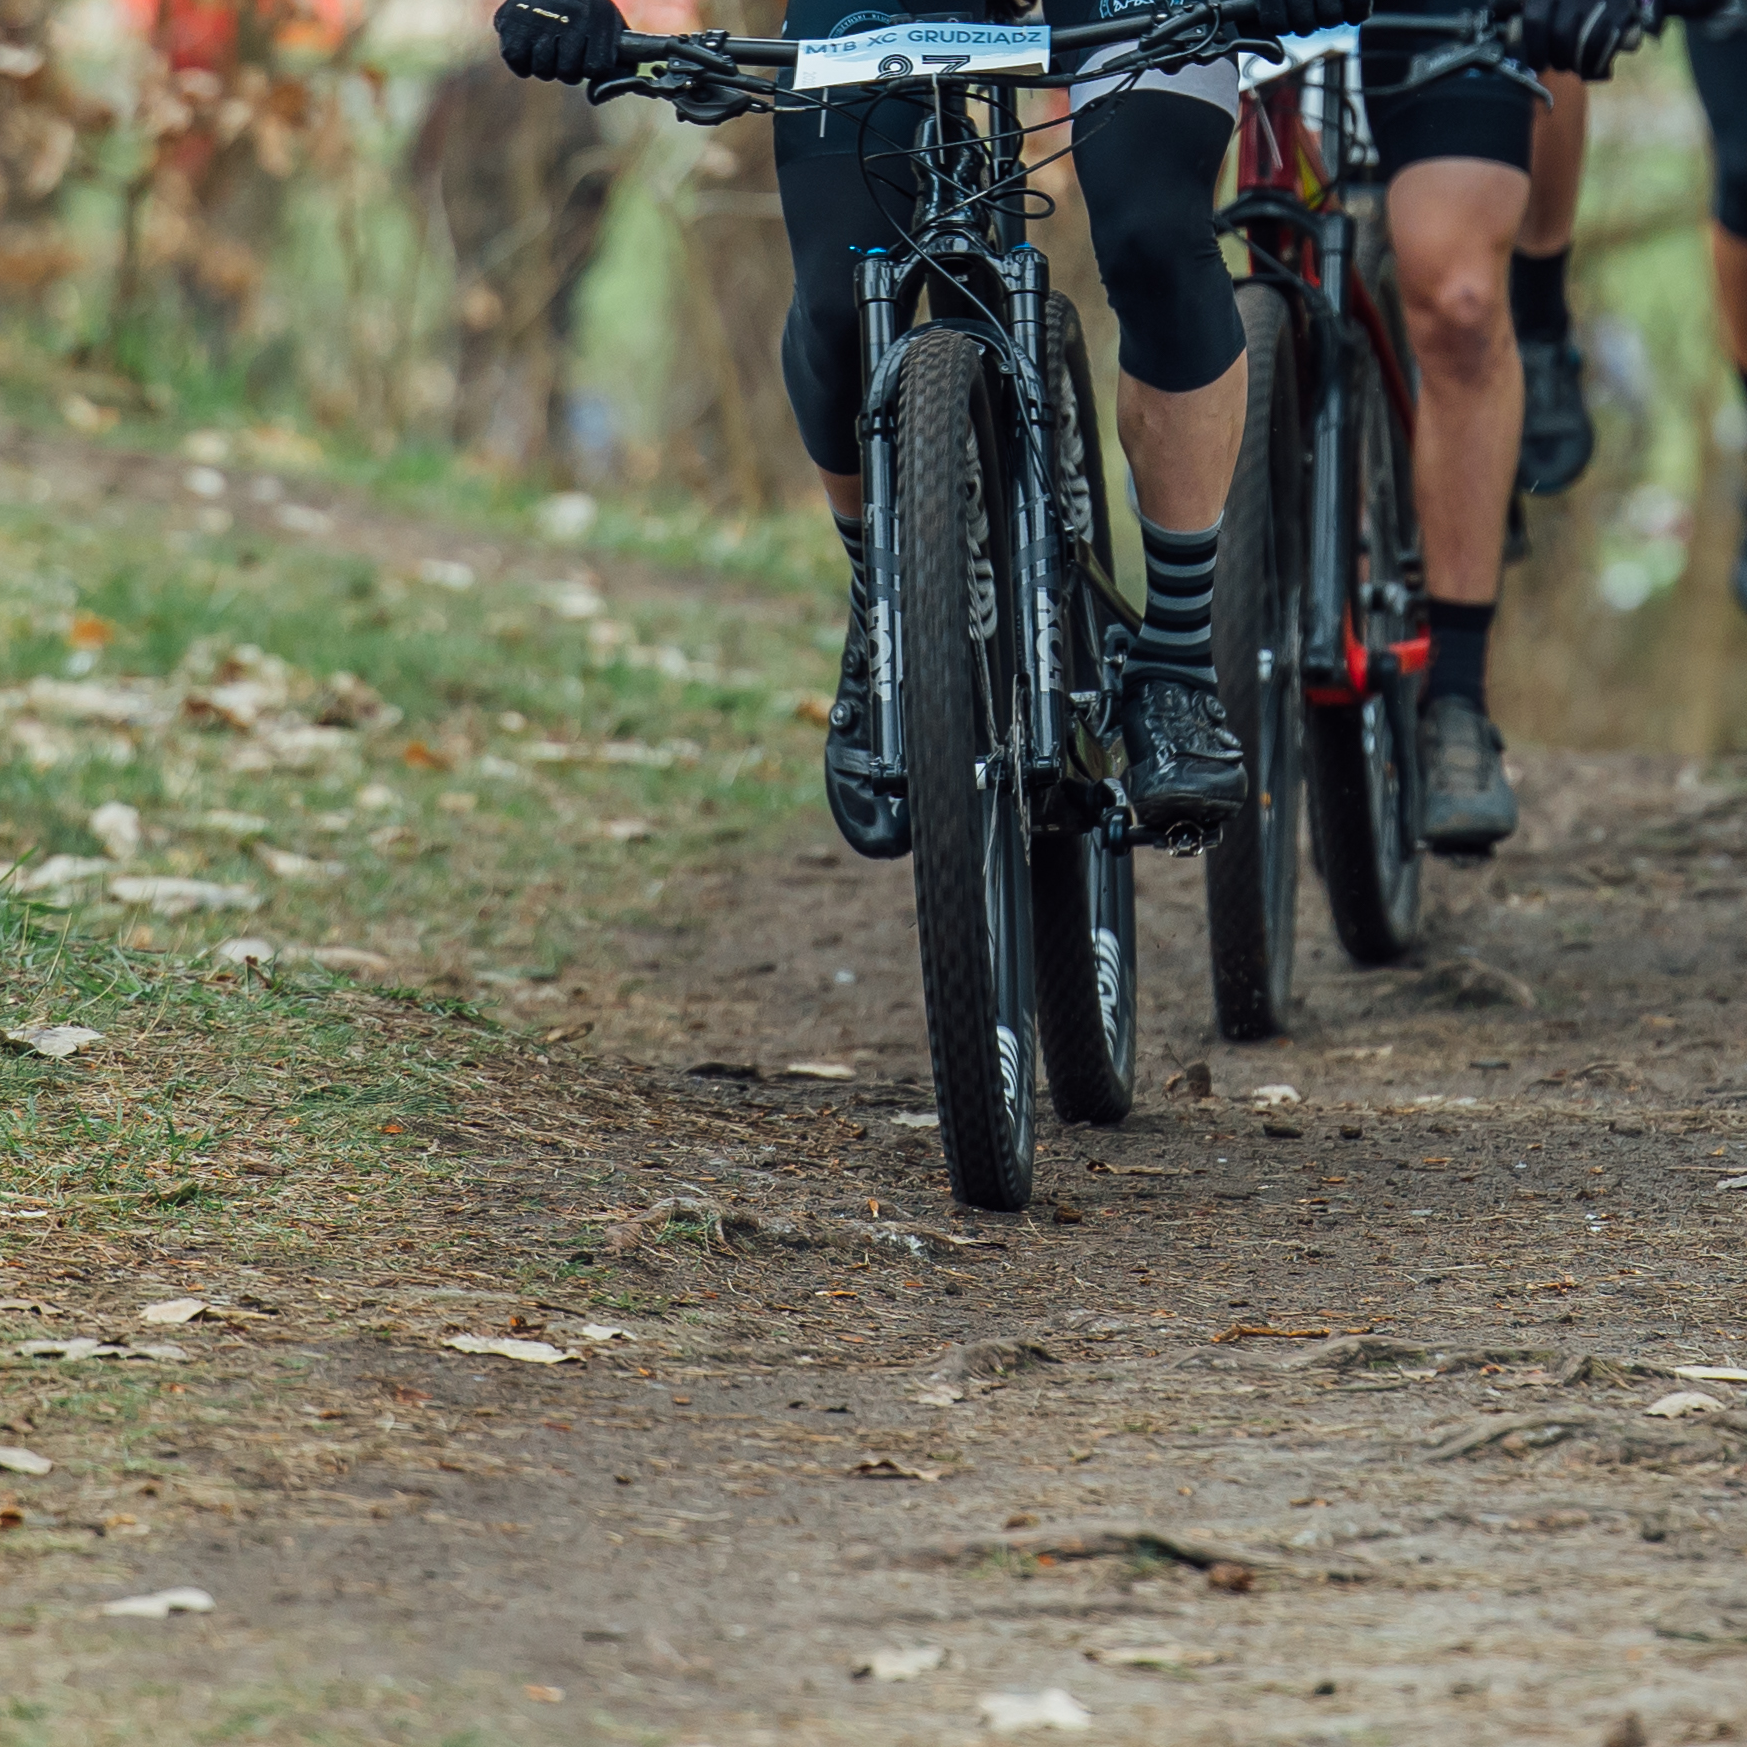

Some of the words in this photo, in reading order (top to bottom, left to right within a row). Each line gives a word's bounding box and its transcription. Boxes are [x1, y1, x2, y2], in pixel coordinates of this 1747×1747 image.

[804, 41, 857, 54] MTB
[867, 31, 898, 47] XC
[907, 29, 1042, 46] GRUDZIĄDZ
